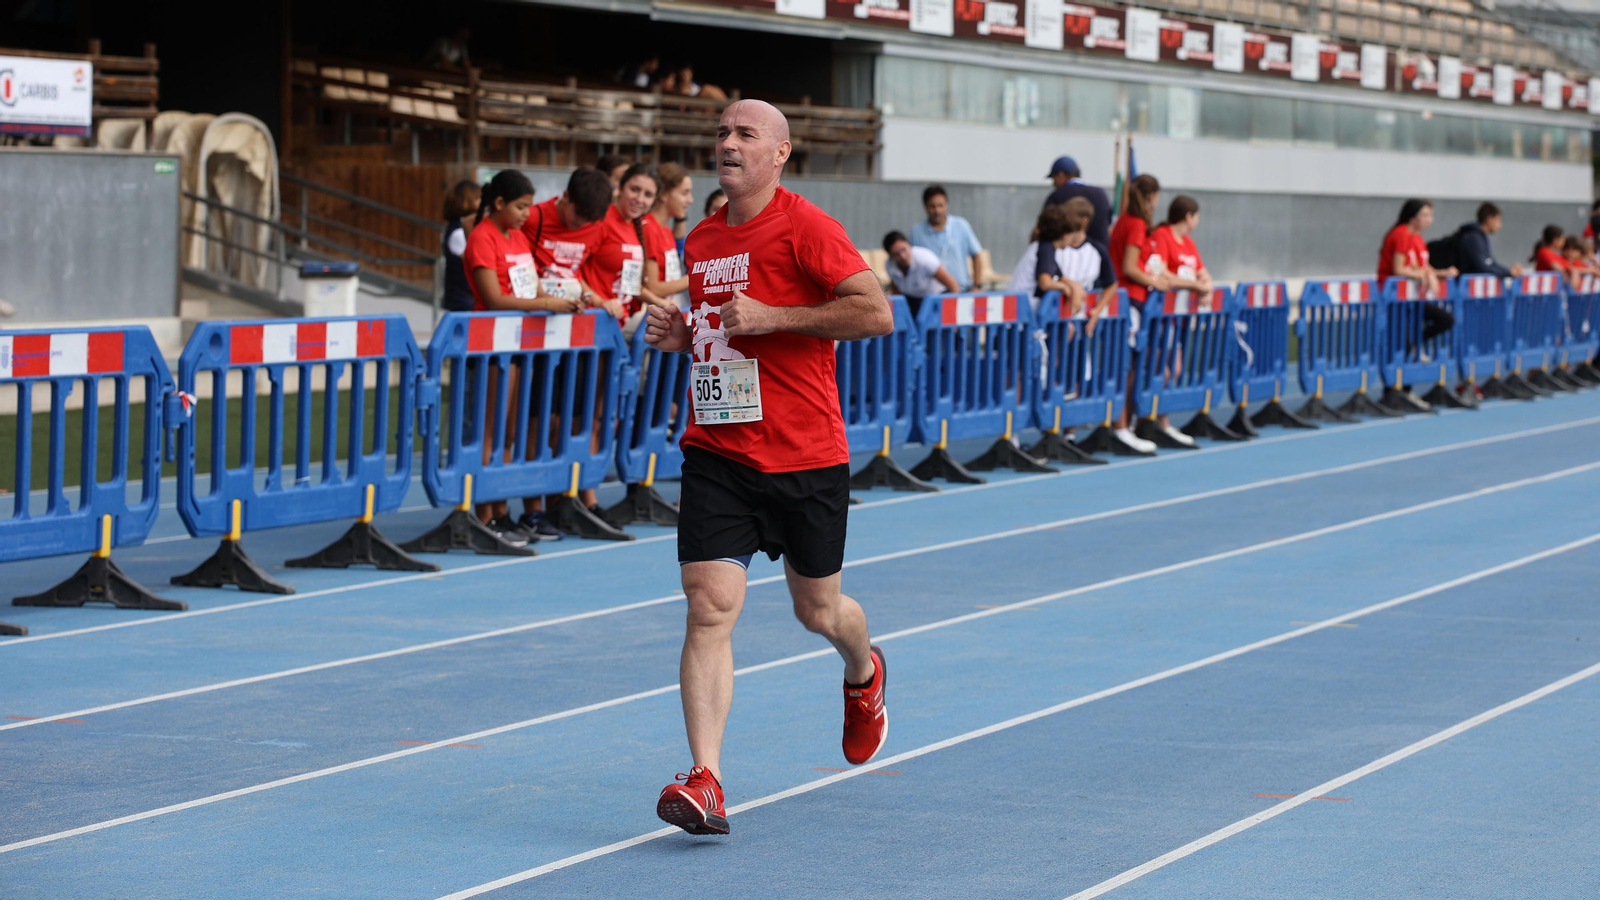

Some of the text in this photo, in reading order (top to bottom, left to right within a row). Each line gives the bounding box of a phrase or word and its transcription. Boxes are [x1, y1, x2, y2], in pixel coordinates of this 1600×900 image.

[706, 252, 750, 272] CARRERA
[703, 266, 748, 286] POPULAR
[724, 284, 732, 292] DE
[696, 378, 722, 402] 505
